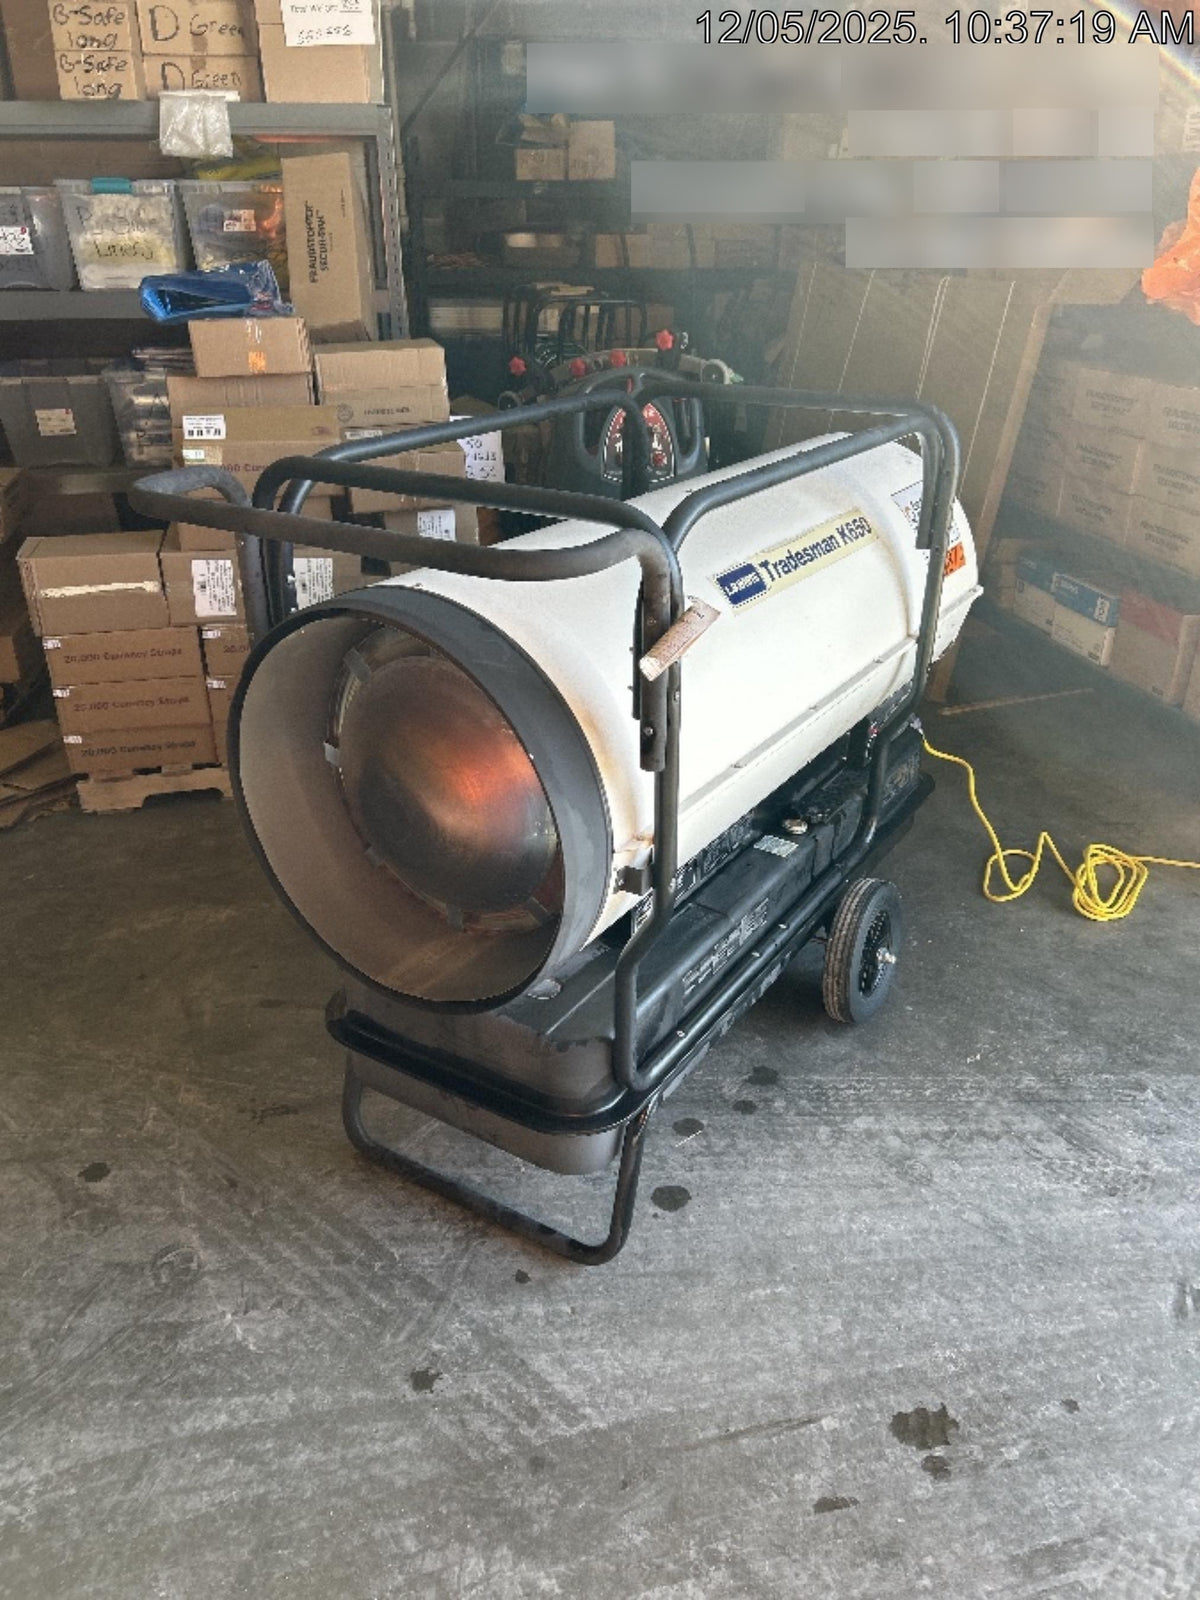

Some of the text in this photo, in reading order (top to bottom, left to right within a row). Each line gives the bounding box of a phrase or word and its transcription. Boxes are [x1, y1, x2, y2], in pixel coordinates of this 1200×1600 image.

[53, 3, 126, 26] B-Safe
[150, 5, 180, 42] D
[59, 53, 128, 73] B-Safe
[161, 62, 186, 91] D
[758, 516, 872, 582] Tradesman K650
